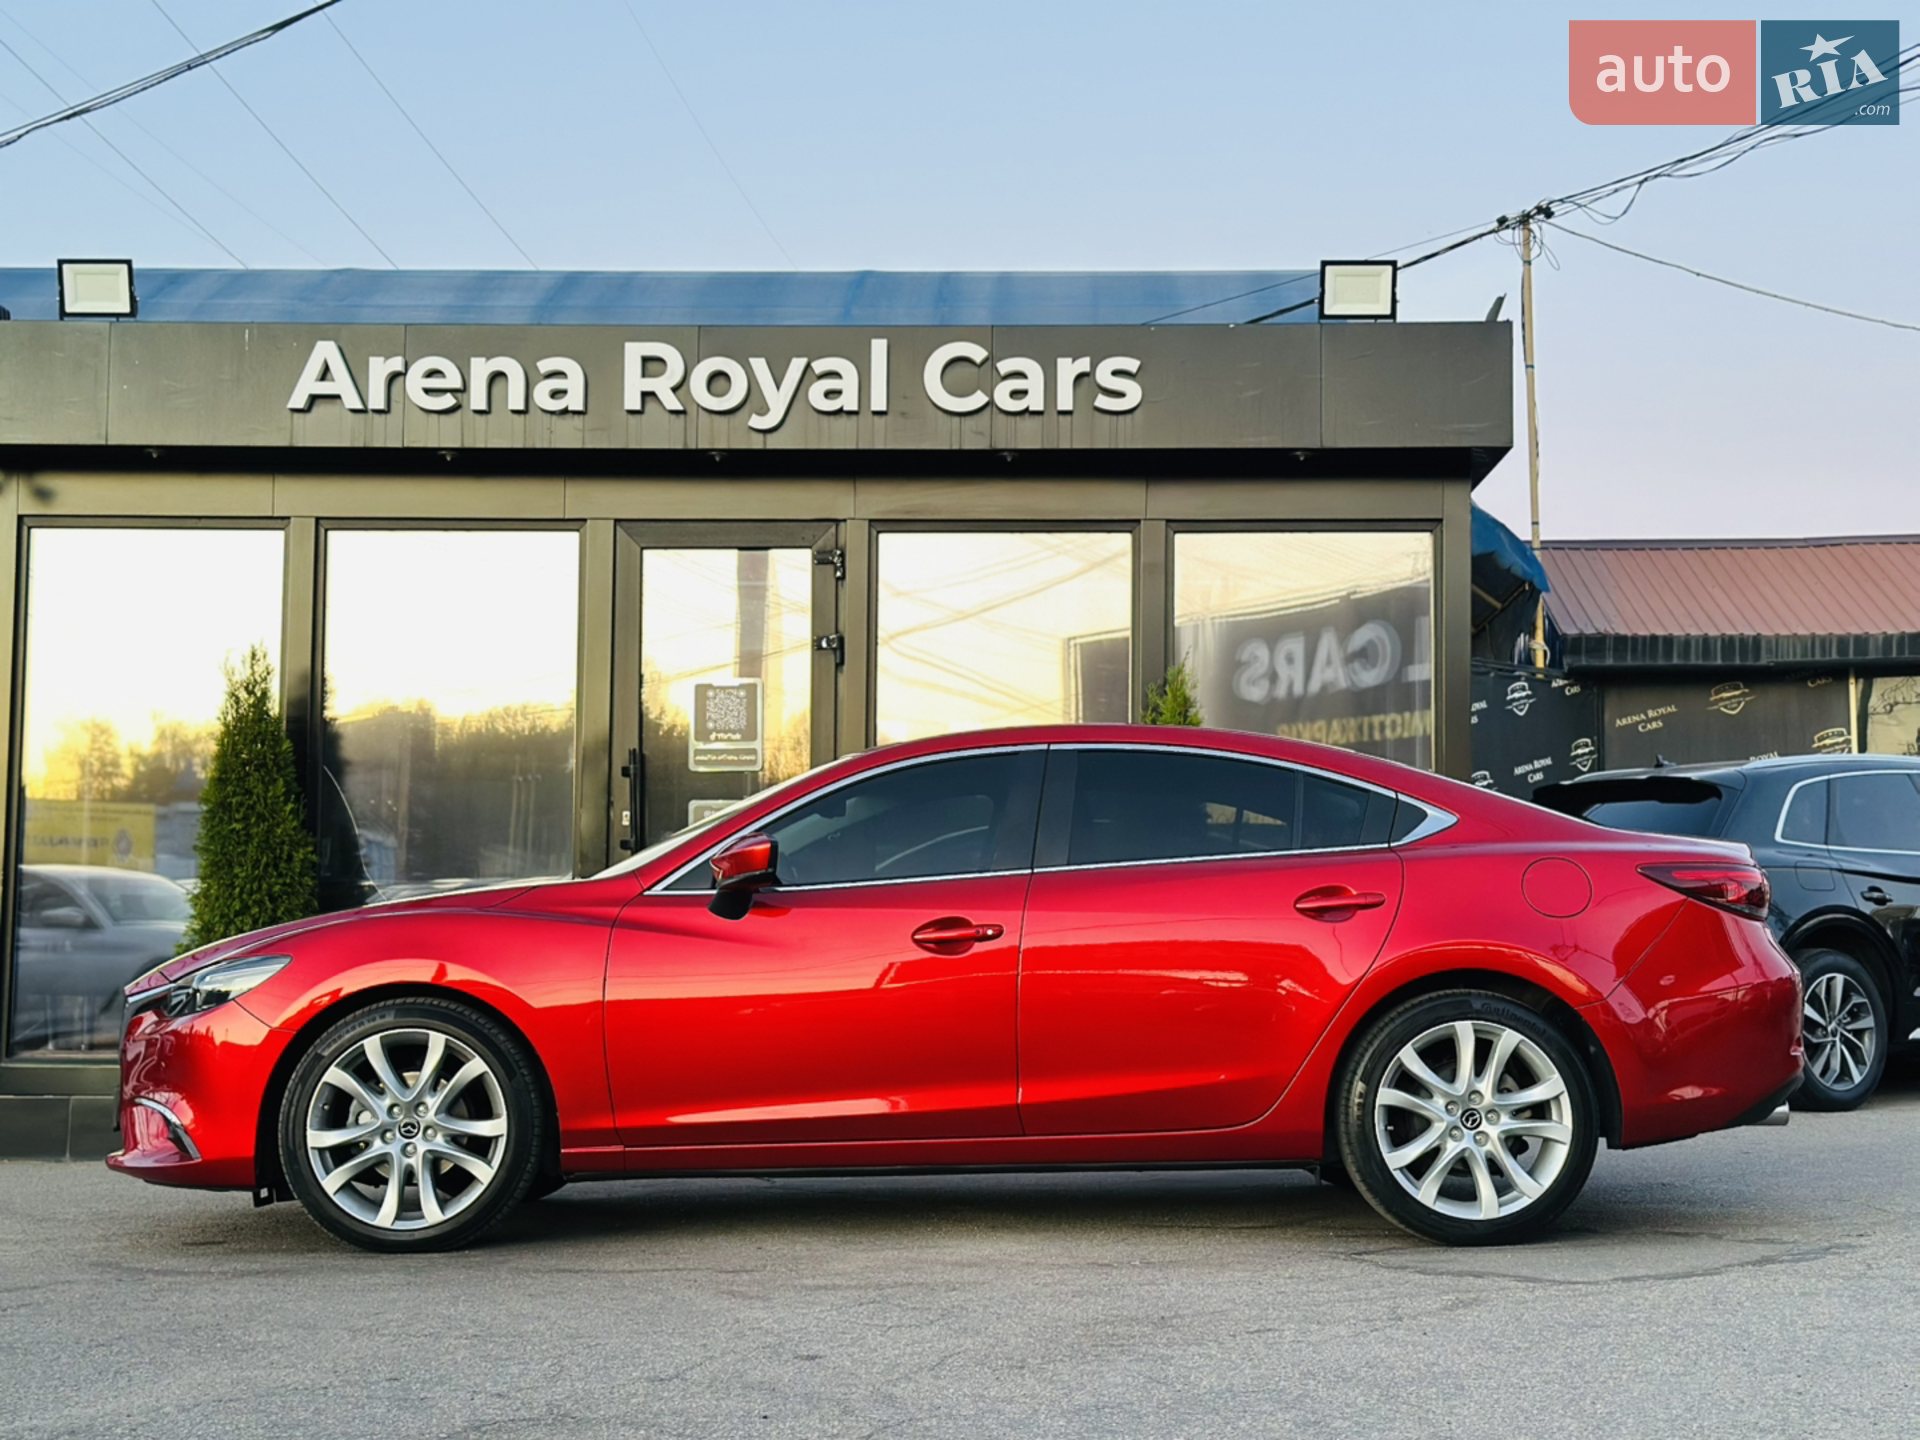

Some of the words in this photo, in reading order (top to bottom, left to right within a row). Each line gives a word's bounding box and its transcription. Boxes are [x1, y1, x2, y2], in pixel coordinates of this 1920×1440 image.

[287, 340, 587, 413] Arena
[624, 338, 889, 432] Royal
[923, 341, 1143, 414] Cars
[1615, 713, 1647, 728] ARENA
[1647, 704, 1678, 719] ROYAL
[1637, 720, 1663, 733] CARS
